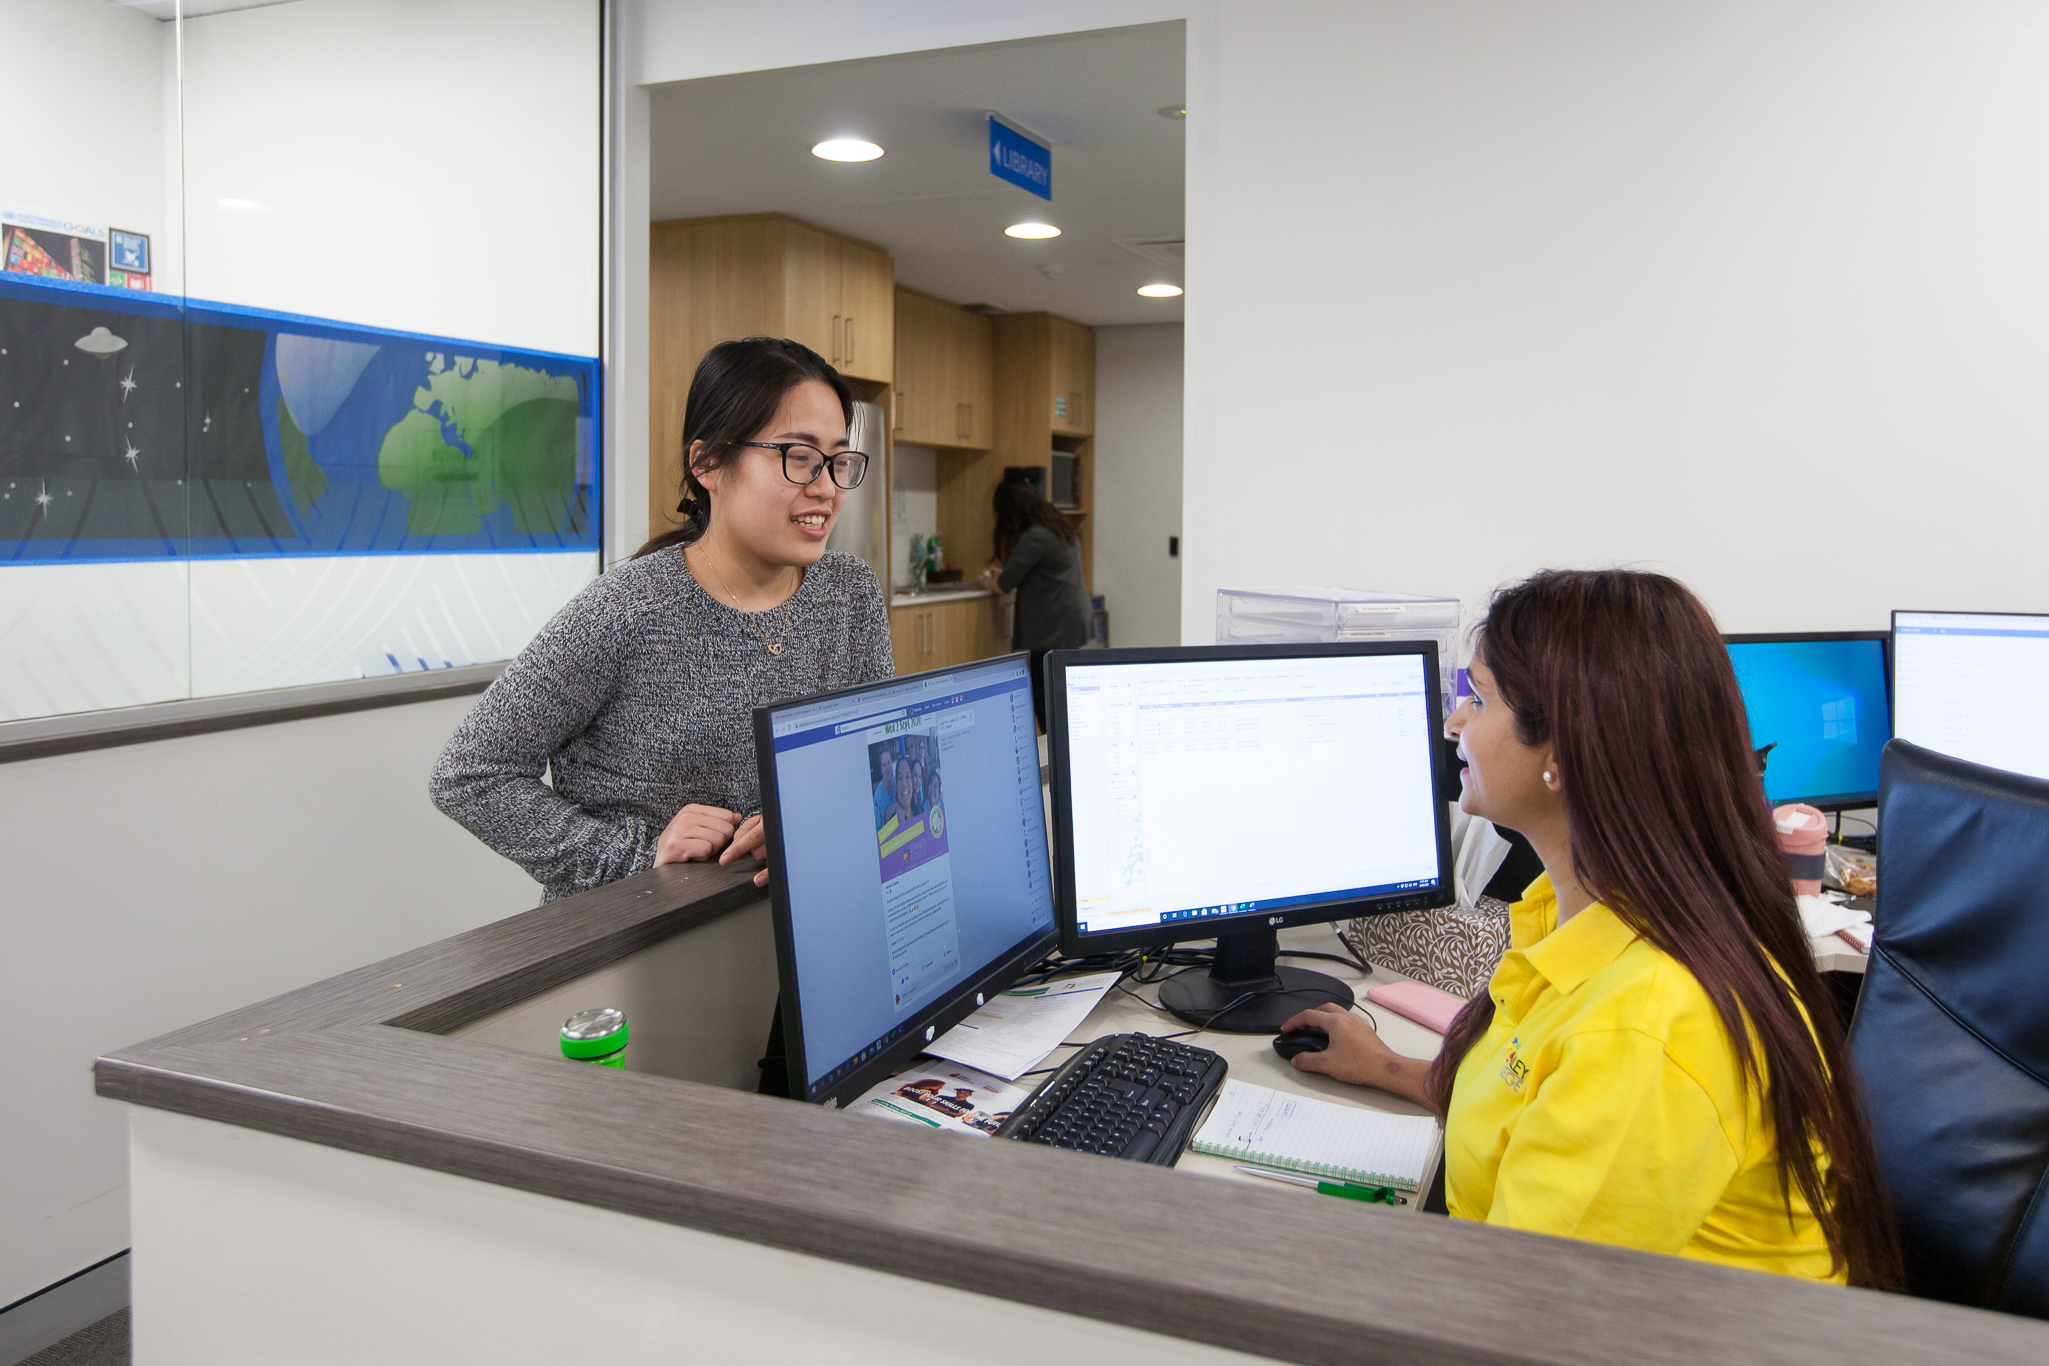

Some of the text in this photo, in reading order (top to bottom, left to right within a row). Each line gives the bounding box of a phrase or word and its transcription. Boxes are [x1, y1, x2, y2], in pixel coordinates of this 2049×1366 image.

[1002, 145, 1049, 187] LIBRARY
[63, 221, 105, 238] GOALS
[885, 723, 895, 735] Wed
[940, 1099, 961, 1111] SKILLS
